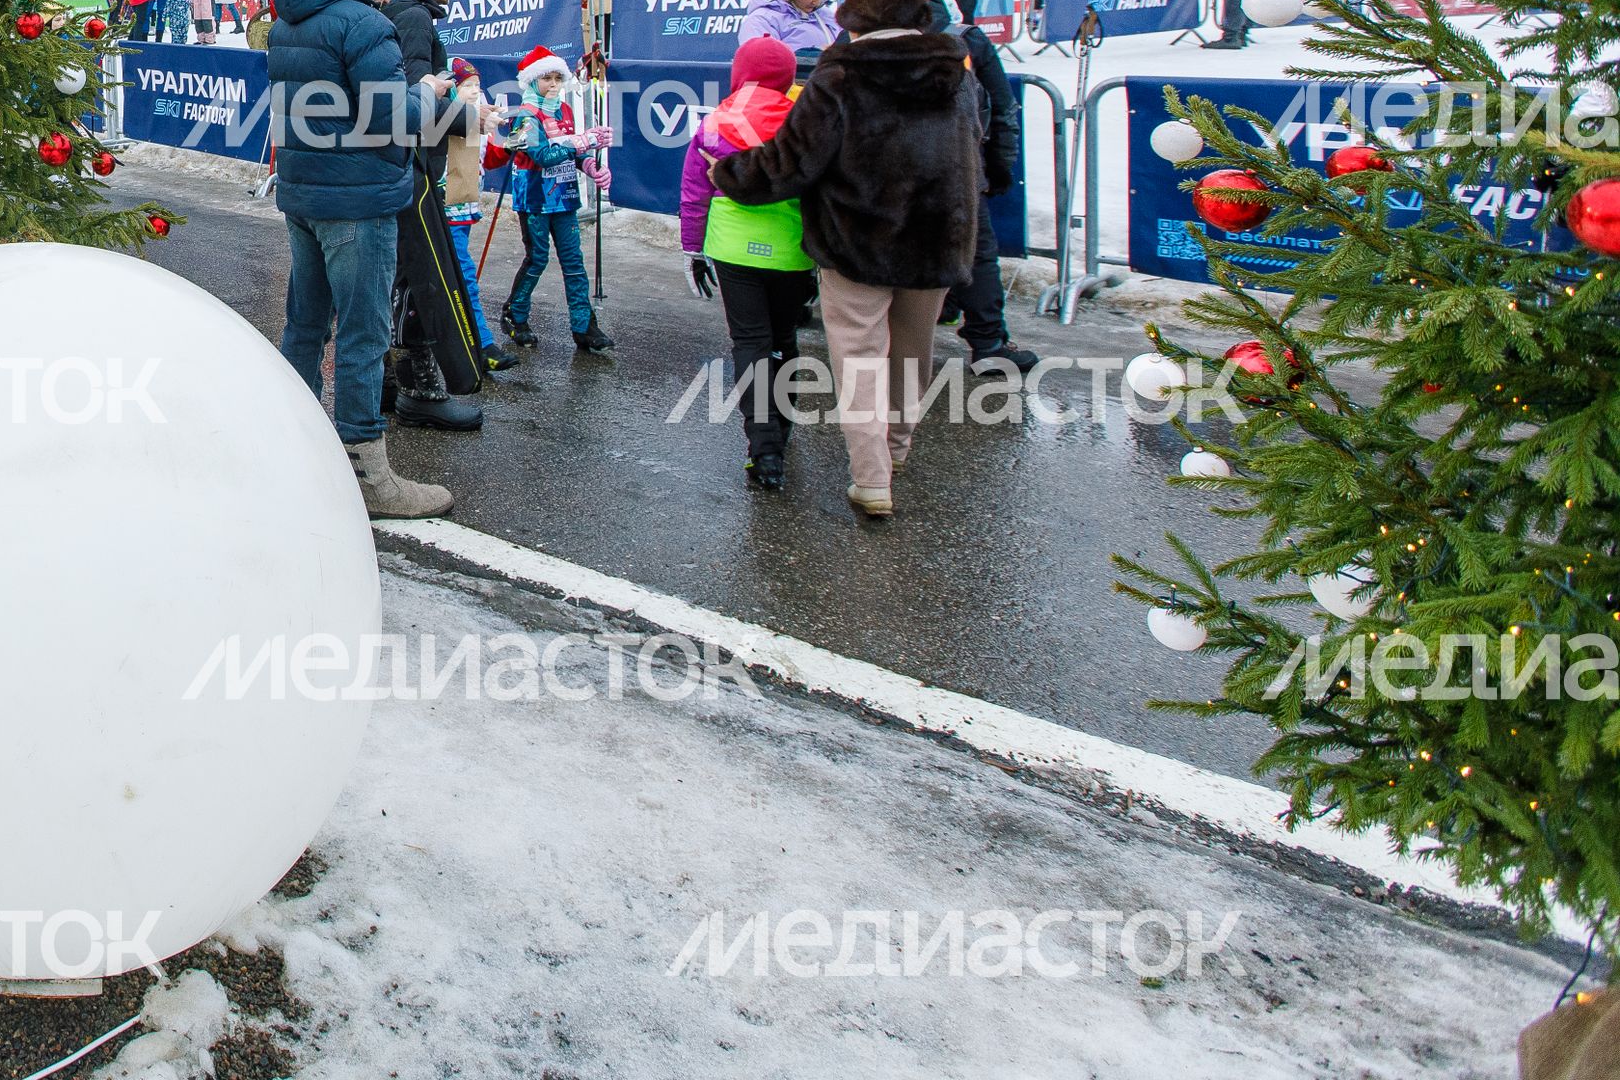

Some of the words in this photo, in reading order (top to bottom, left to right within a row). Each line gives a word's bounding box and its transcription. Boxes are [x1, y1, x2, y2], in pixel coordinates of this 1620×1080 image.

[474, 16, 531, 41] FACTORY
[662, 16, 702, 36] SKI
[137, 68, 247, 103] УРАЛХИМ
[153, 98, 181, 118] SKI
[183, 102, 235, 126] FACTORY
